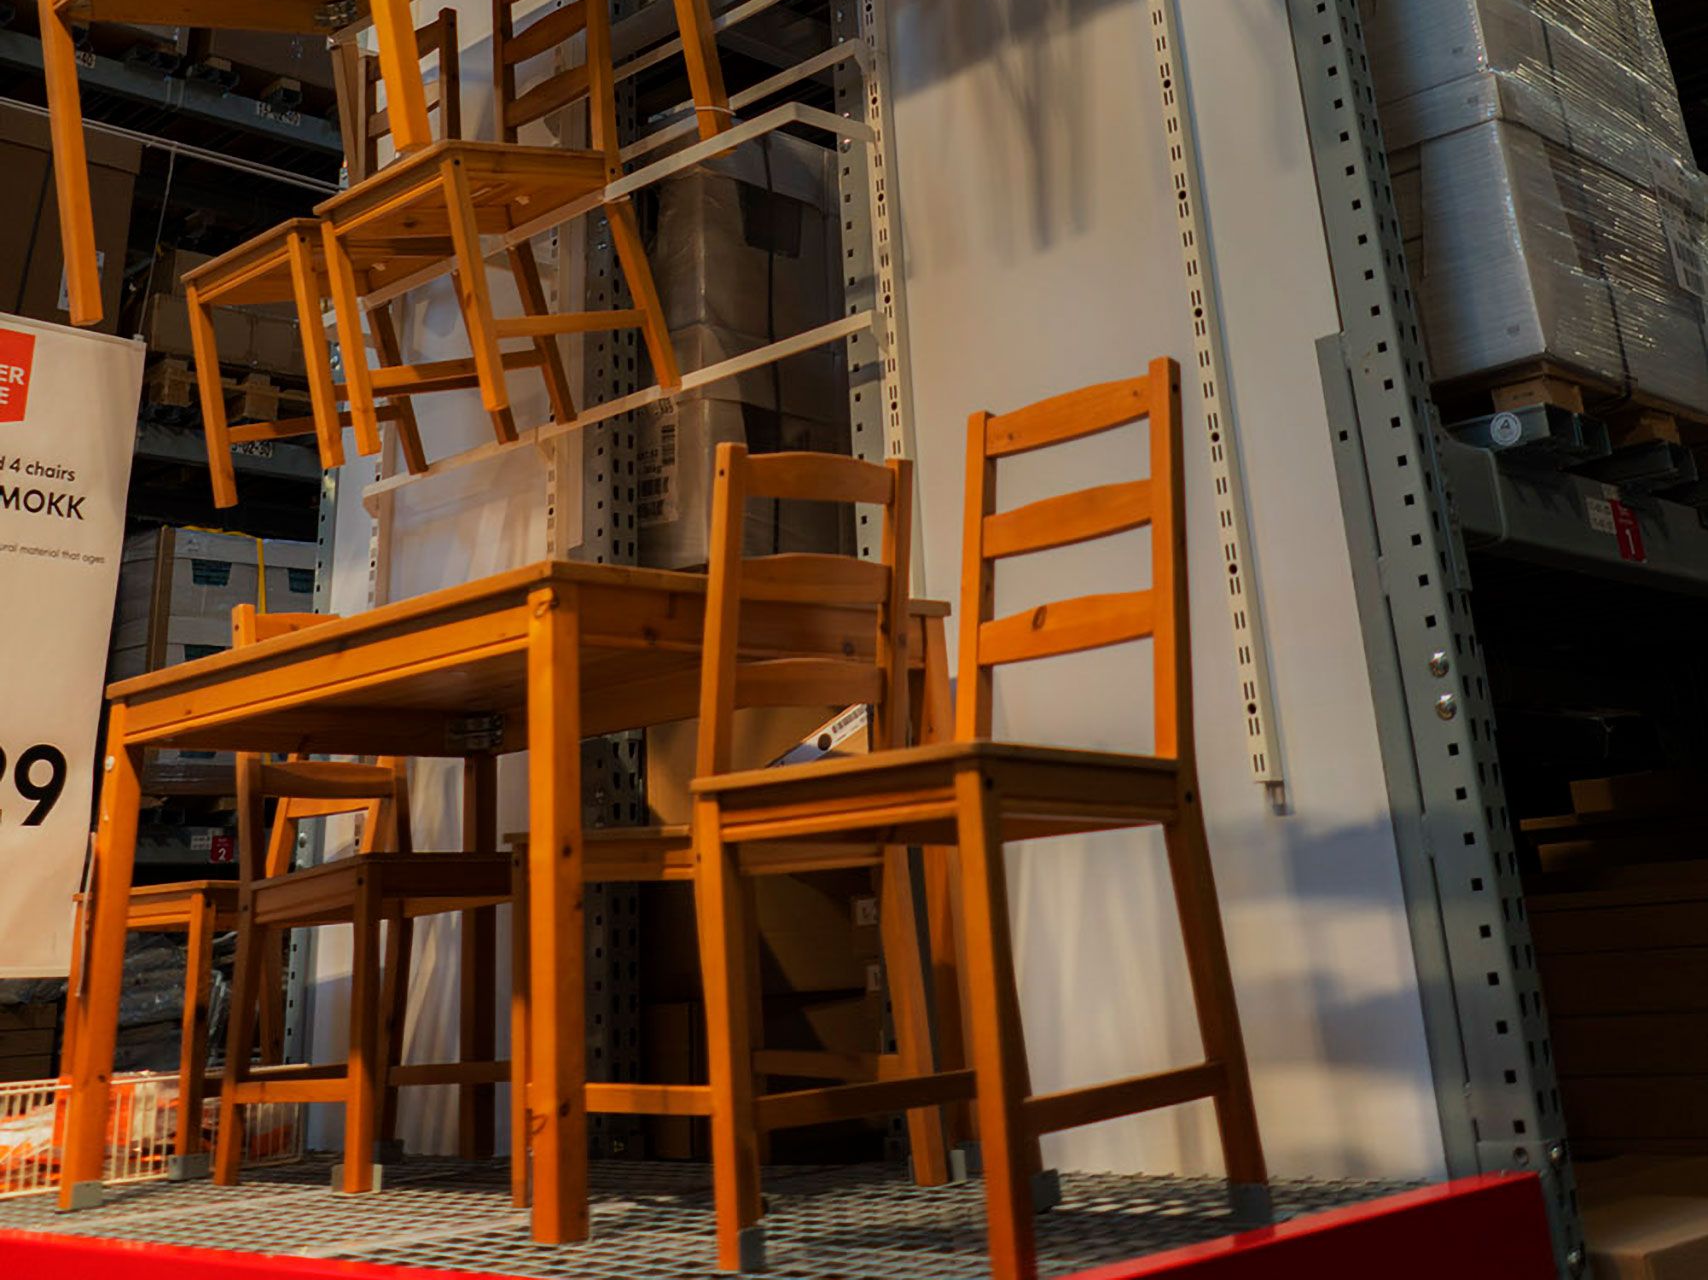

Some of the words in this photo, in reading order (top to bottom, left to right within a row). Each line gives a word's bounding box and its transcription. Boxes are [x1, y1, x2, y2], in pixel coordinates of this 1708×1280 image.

[9, 458, 20, 472] 4
[25, 461, 76, 482] chairs
[0, 485, 86, 521] MOKK
[217, 847, 227, 862] 2
